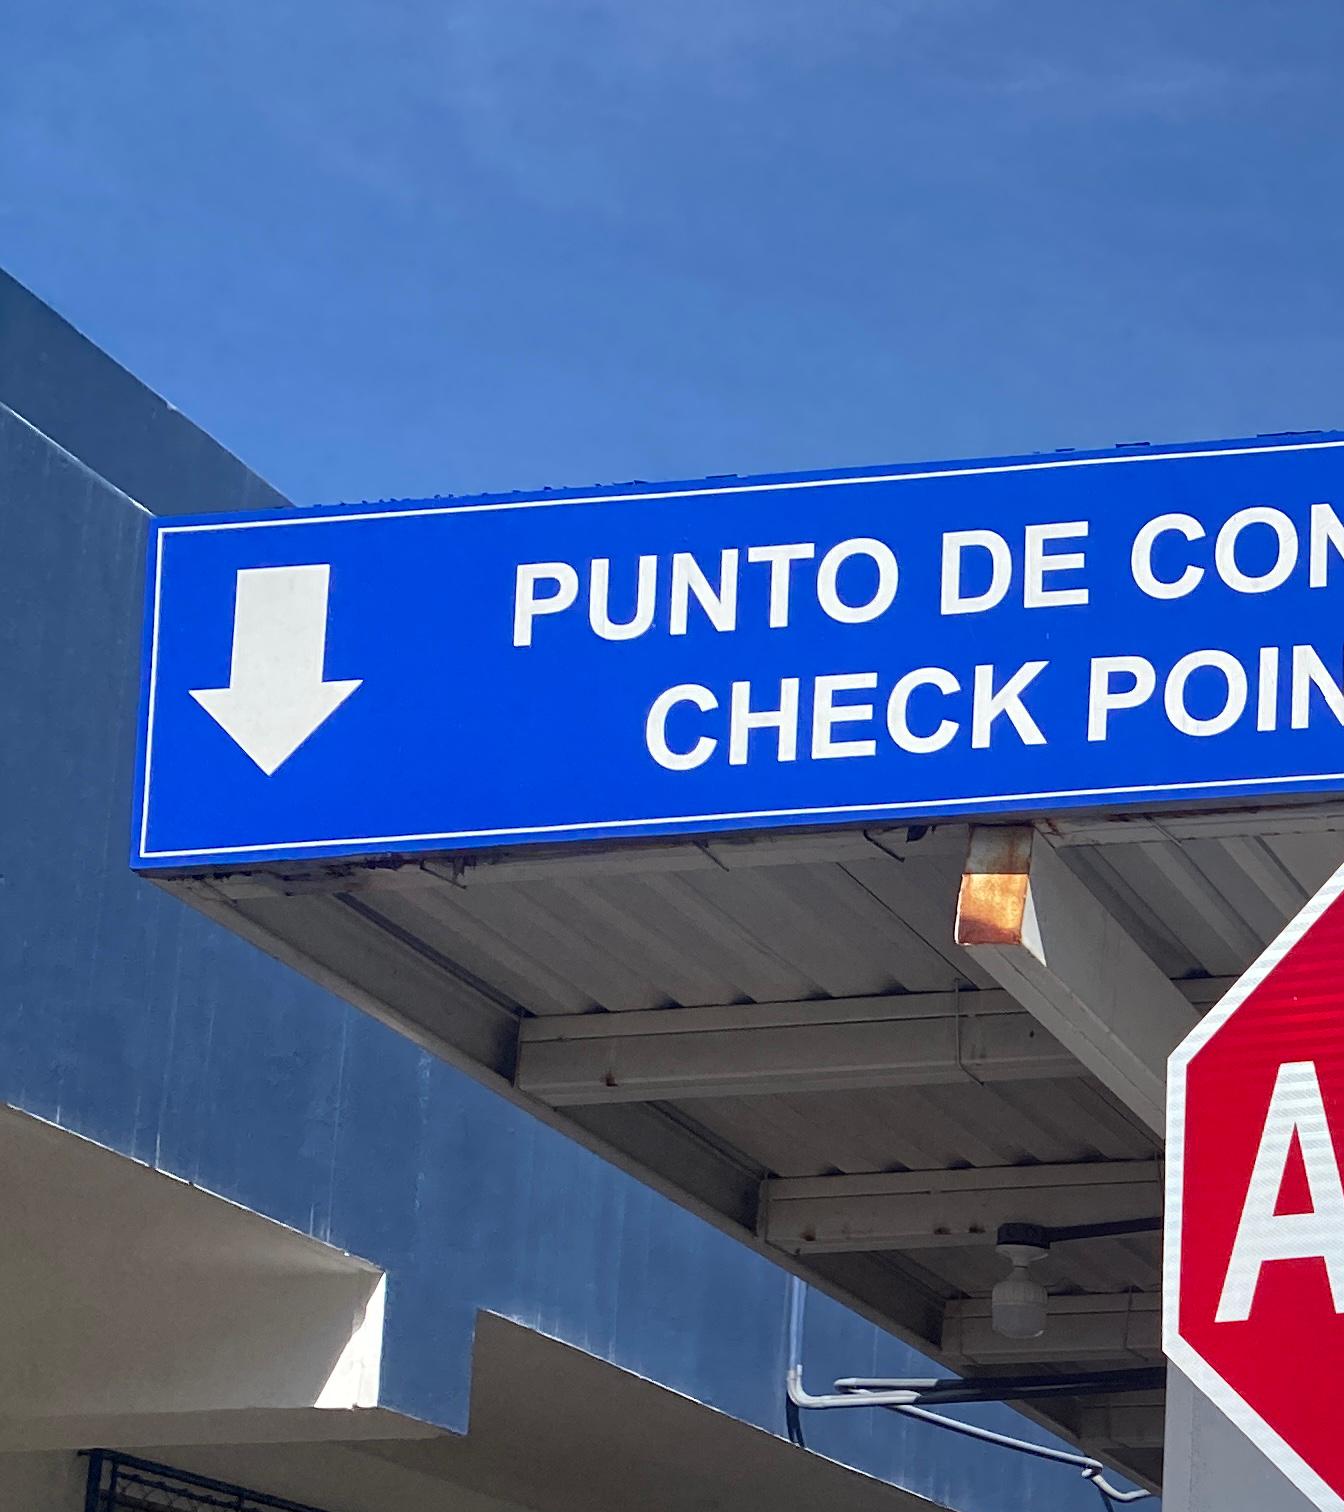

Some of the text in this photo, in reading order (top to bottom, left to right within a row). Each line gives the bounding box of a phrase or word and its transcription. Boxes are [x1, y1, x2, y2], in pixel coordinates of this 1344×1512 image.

[513, 537, 899, 647] PUNTO
[940, 521, 1089, 615] DE
[645, 660, 1049, 771] CHECK
